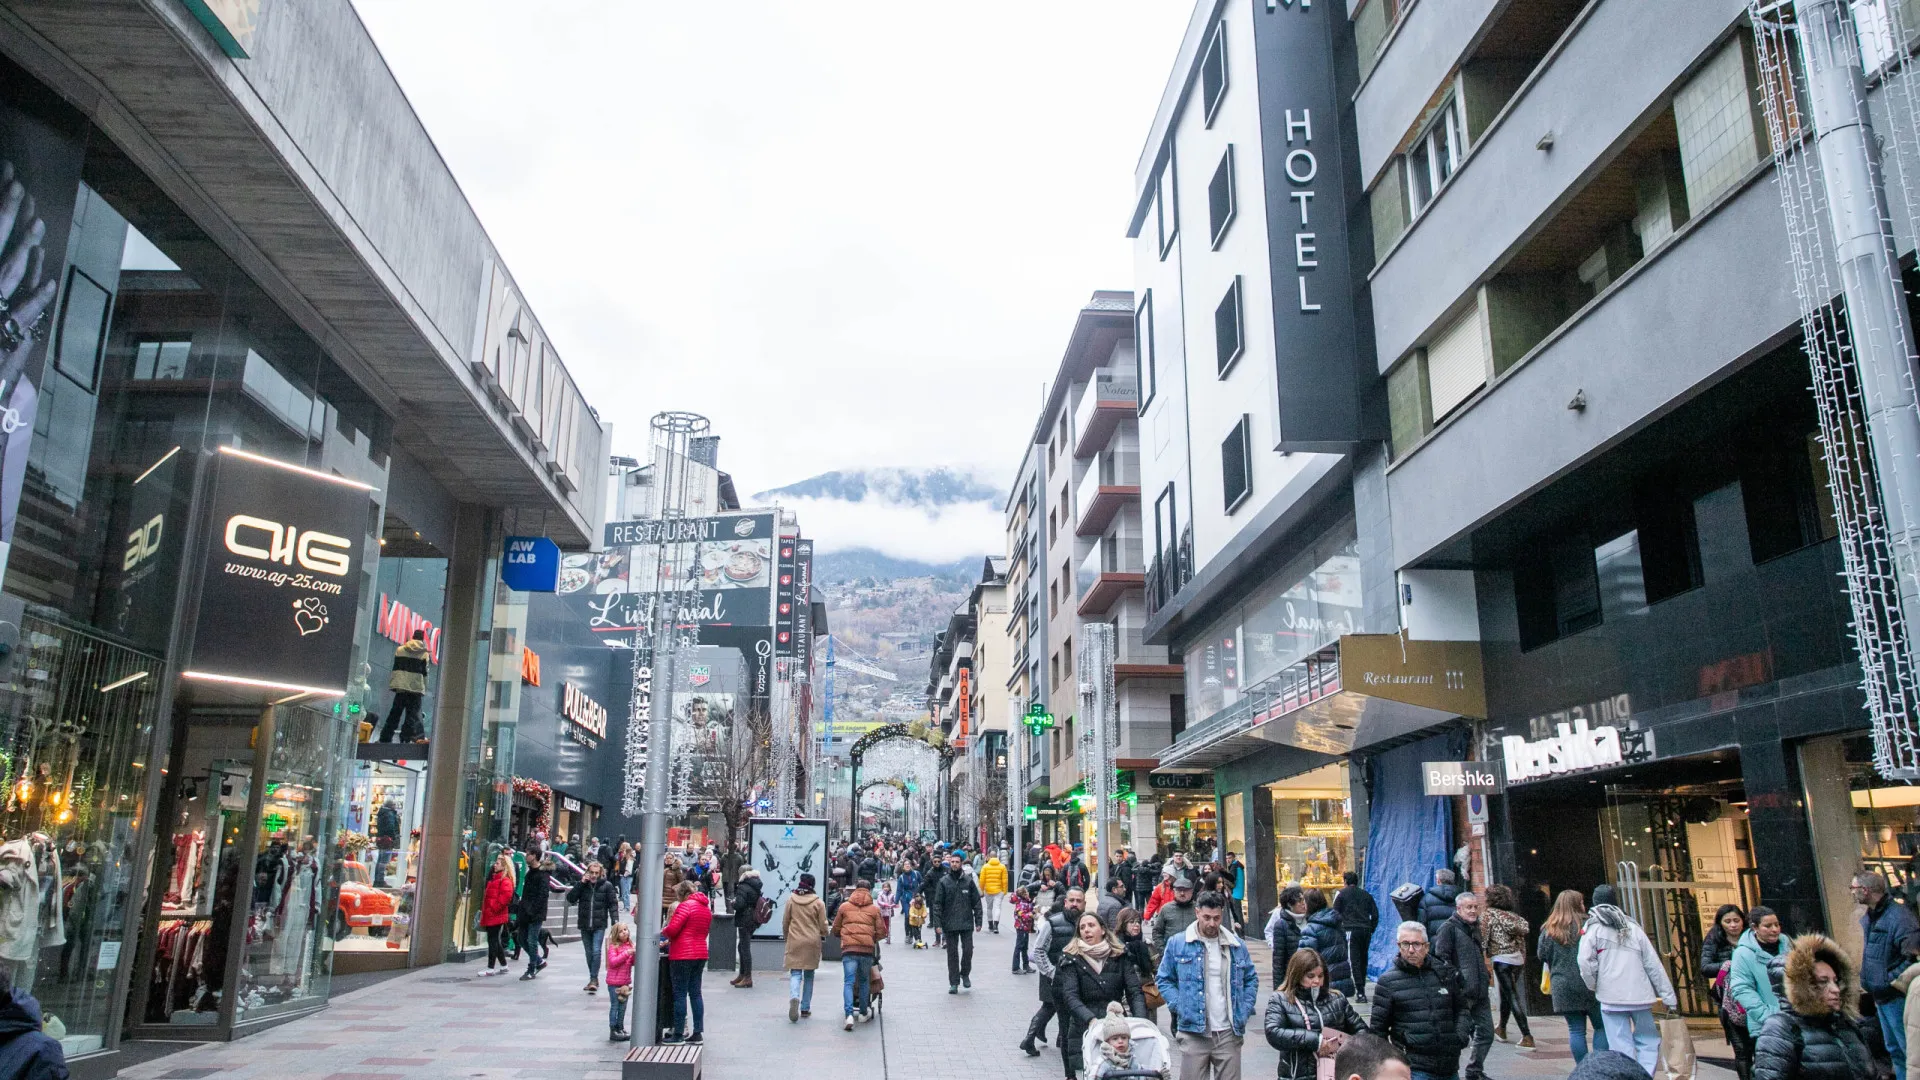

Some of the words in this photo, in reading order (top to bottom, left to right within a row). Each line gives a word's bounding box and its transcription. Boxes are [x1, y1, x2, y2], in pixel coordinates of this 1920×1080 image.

[1285, 108, 1321, 311] HOTEL
[613, 521, 720, 543] RESTAURANT
[510, 541, 534, 551] AW
[508, 553, 536, 564] LAB
[224, 562, 342, 595] www.ag-25.com
[588, 591, 726, 637] L'infmal
[755, 639, 771, 693] QUARS
[1363, 671, 1434, 686] Restaurant
[564, 682, 607, 740] PULL&BEAR
[573, 728, 587, 745] SINCE
[1502, 718, 1623, 781] Bershka
[1430, 770, 1495, 787] Bershka
[1697, 857, 1704, 870] 0
[1700, 891, 1708, 903] -1
